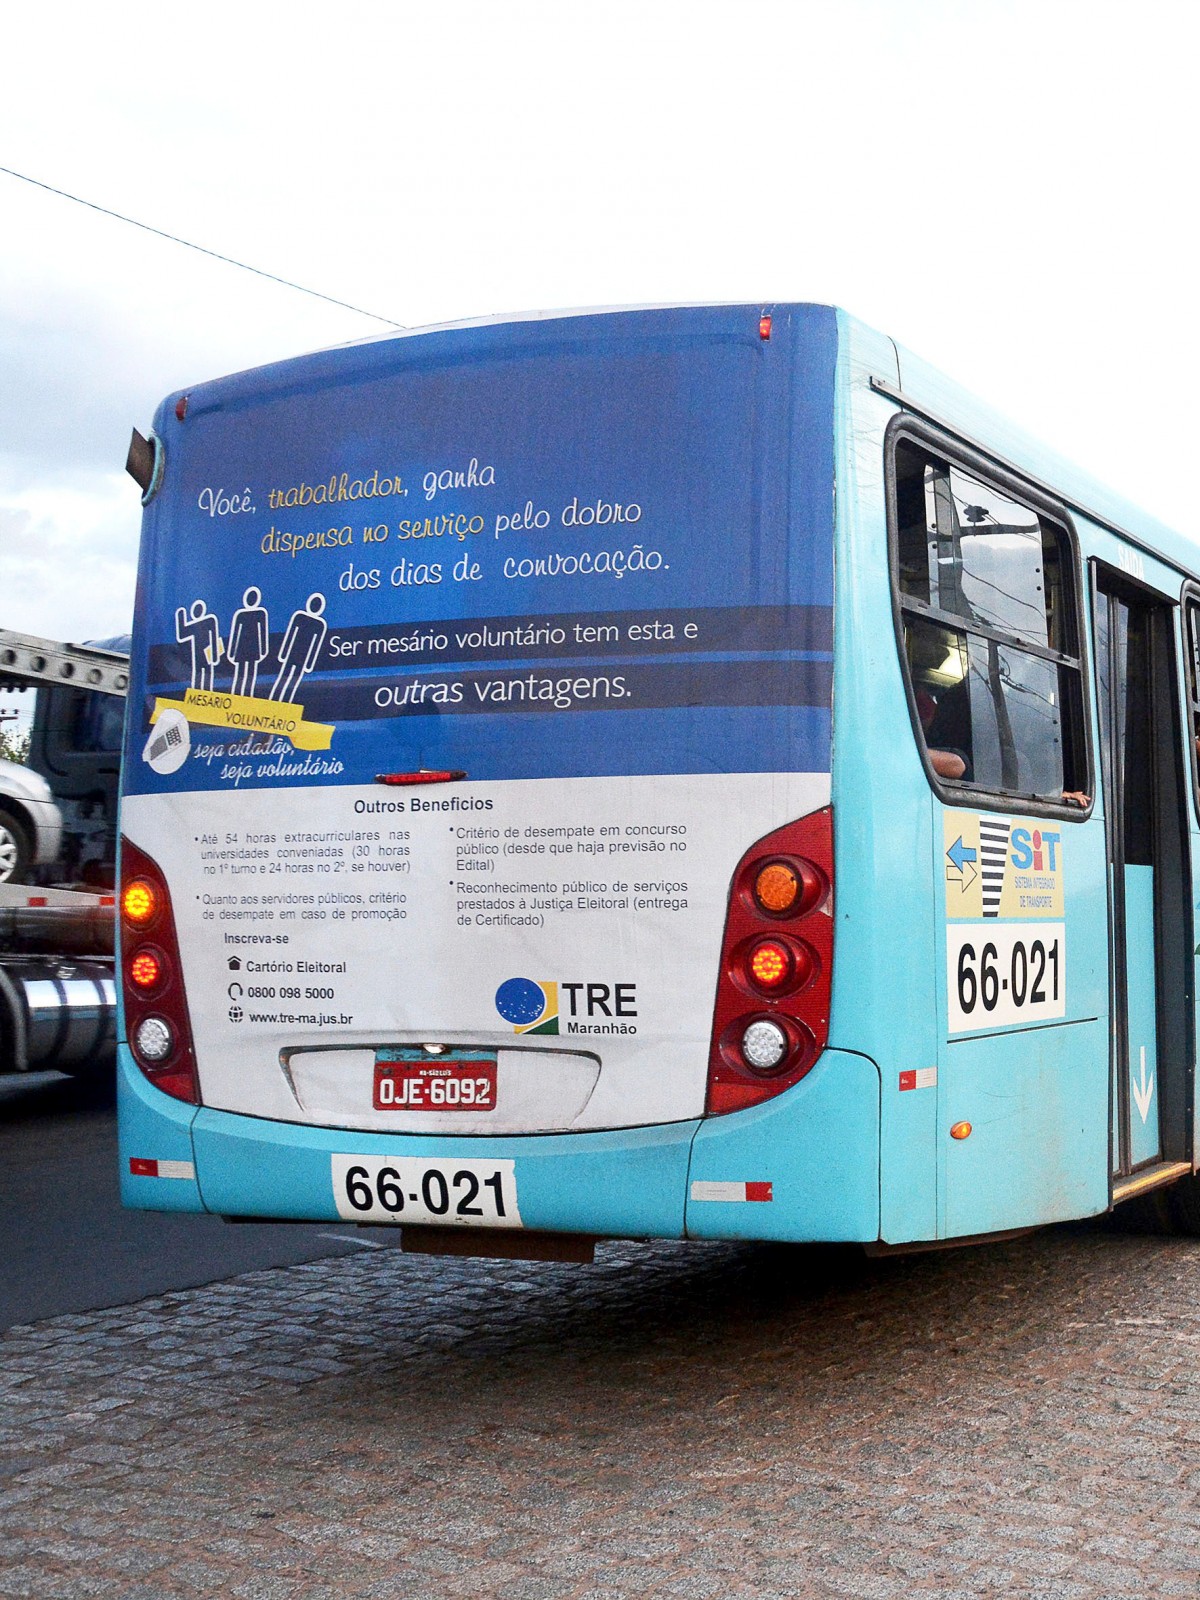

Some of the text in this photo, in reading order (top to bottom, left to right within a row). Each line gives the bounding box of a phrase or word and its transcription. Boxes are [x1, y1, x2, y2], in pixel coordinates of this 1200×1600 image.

[198, 458, 496, 517] Você, trabalhador, ganha
[261, 497, 642, 558] dispensa no serviço pelo dobro
[339, 545, 670, 592] dos dias de convocação.
[329, 620, 699, 657] Ser mesário voluntário tem esta e
[375, 674, 632, 709] outras vantagens.
[225, 712, 297, 732] VOLUNTÁRIO
[194, 733, 294, 766] seja cidadão,
[221, 754, 344, 787] seja voluntário
[354, 800, 405, 814] Outros
[201, 830, 410, 845] Até 54 horas extracurriculares nas
[456, 825, 687, 841] Critério de desempate em concurso
[201, 845, 410, 860] universidades conveniadas (30 horas
[456, 840, 687, 858] público (desde que haja previsão no
[203, 865, 216, 874] no
[259, 865, 266, 874] e
[269, 862, 282, 873] 24
[285, 862, 314, 873] horas
[317, 864, 330, 873] no
[351, 864, 364, 872] se
[368, 860, 411, 874] houver)
[456, 859, 495, 873] Edital)
[456, 880, 688, 895] Reconhecimento público de serviços
[202, 892, 407, 906] Quanto aos servidores públicos, critério
[457, 897, 688, 912] prestados à Justiça Eleitoral (entrega
[202, 907, 407, 921] de desempate em caso de promoção
[457, 914, 545, 929] de Certificado)
[224, 933, 289, 944] Inscreva-se
[246, 961, 346, 973] Cartório Eleitoral
[958, 939, 1058, 1014] 66-021
[248, 987, 334, 999] 0800 098 5000
[562, 983, 638, 1017] TRE
[249, 1012, 353, 1027] www.tre-ma.jus.br
[567, 1022, 637, 1035] Maranhão
[346, 1166, 506, 1217] 66-021
